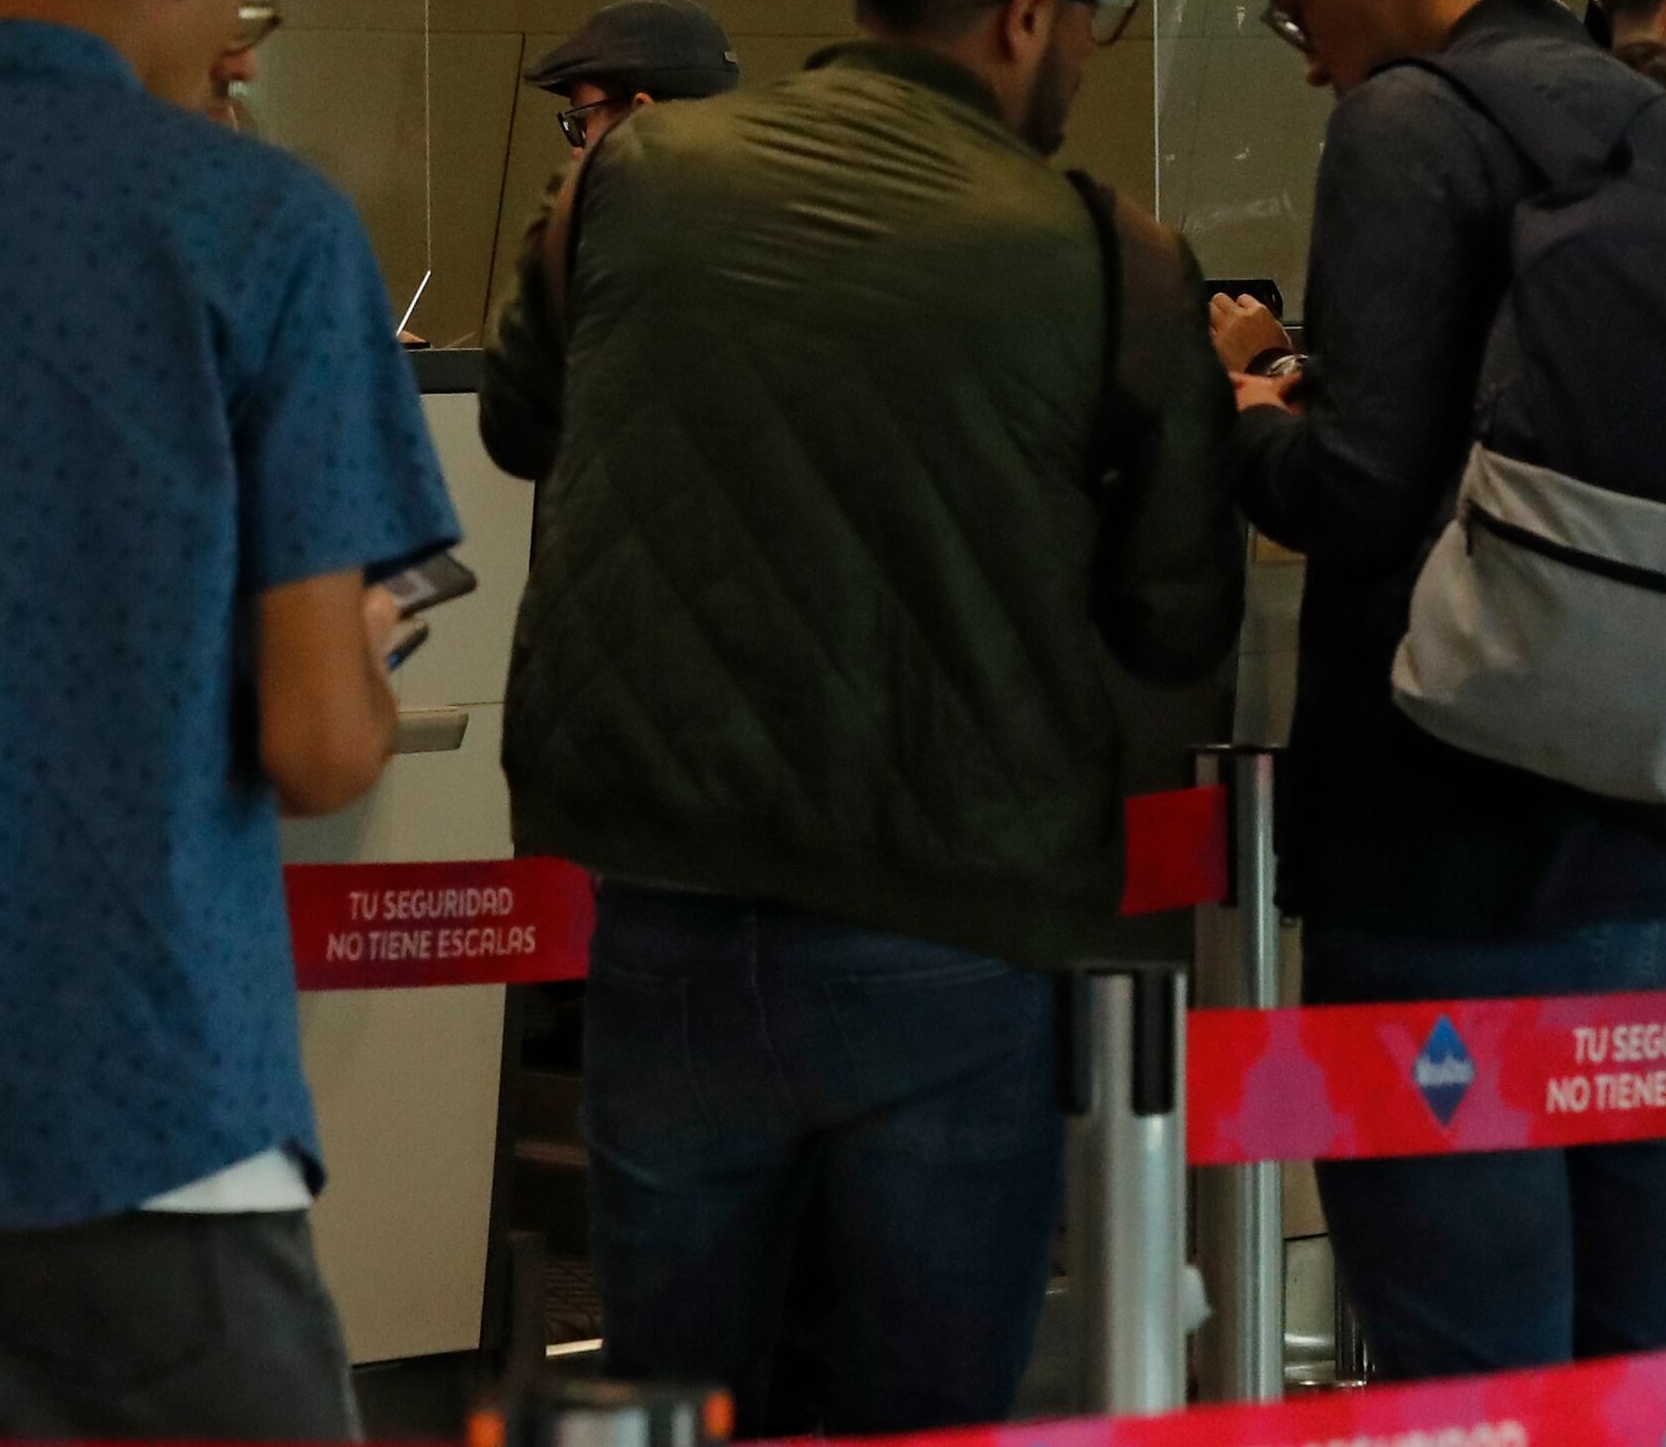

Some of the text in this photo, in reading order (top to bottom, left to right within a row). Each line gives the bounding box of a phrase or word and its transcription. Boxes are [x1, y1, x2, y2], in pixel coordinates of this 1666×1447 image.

[349, 887, 514, 921] TU SEGURIDAD
[327, 926, 536, 962] NO TIENE ESCALAS
[1573, 1027, 1611, 1062] TU
[1546, 1075, 1591, 1114] NO
